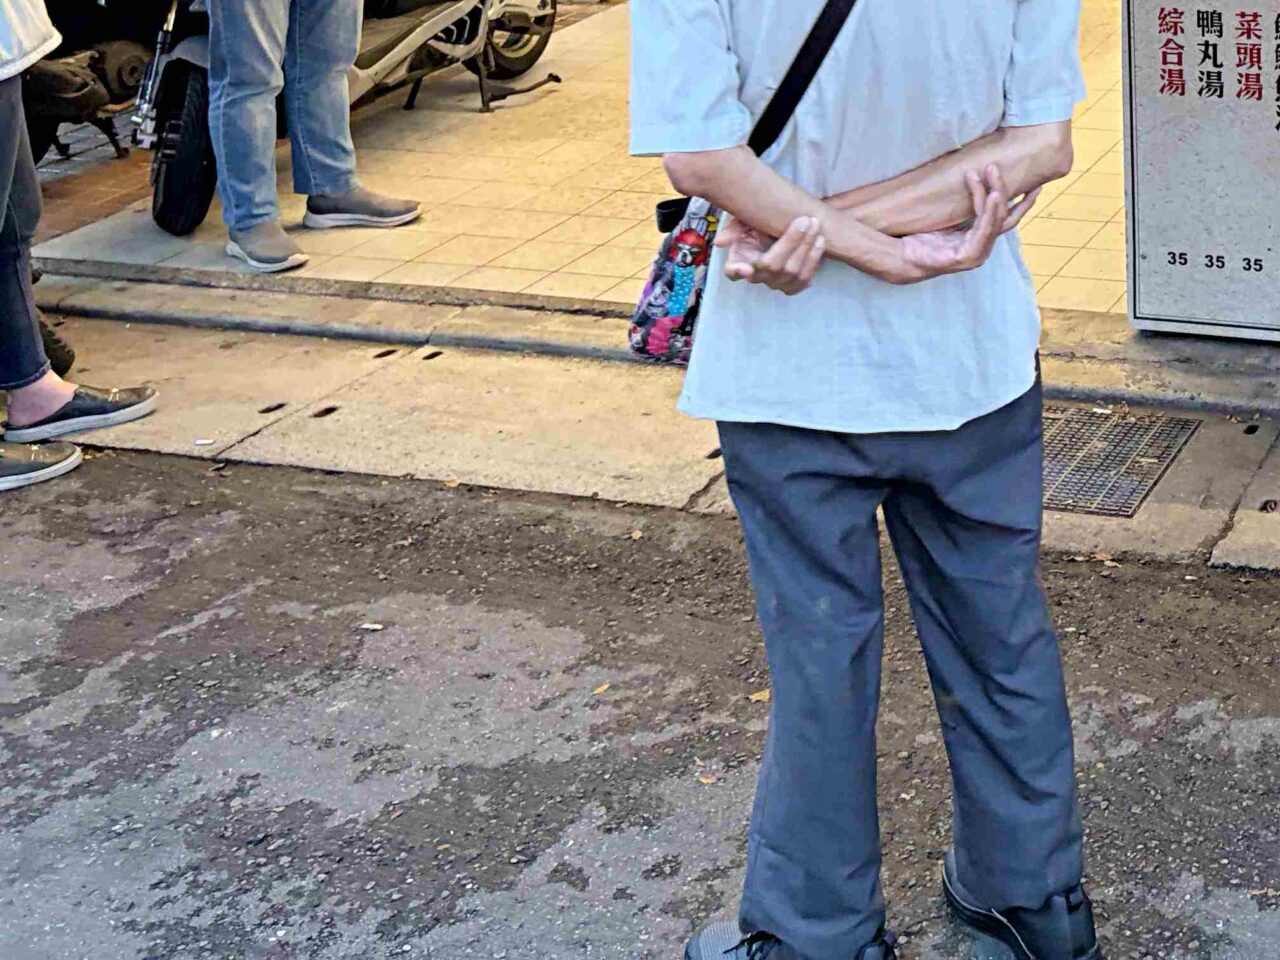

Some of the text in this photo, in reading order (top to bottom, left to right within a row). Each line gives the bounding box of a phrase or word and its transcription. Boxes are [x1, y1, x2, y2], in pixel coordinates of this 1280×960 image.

[1158, 7, 1185, 94] 綜合湯
[1196, 9, 1225, 99] 鴨丸湯
[1235, 10, 1262, 101] 菜頭湯
[1167, 251, 1188, 266] 35
[1204, 254, 1226, 269] 35
[1242, 257, 1263, 272] 35
